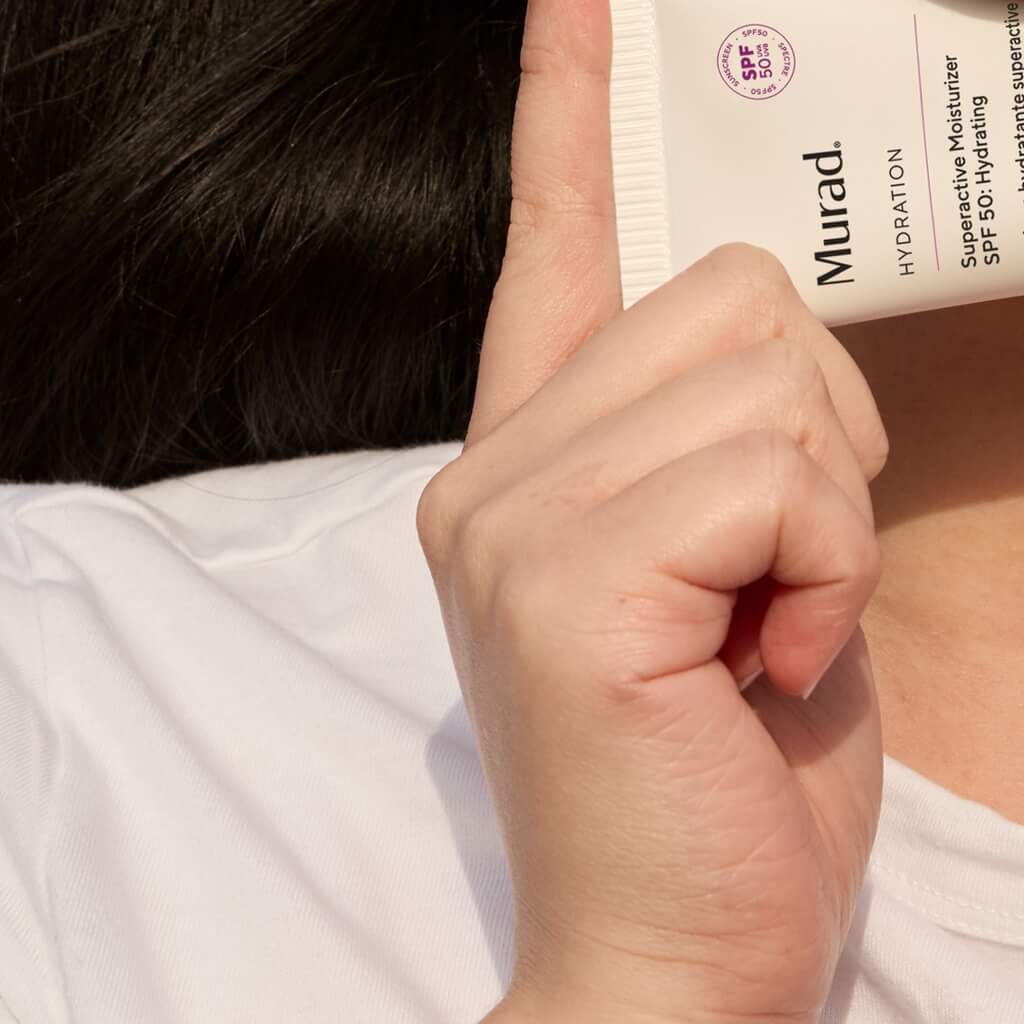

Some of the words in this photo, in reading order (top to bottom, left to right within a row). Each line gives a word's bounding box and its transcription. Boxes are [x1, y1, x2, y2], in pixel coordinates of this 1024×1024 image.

[722, 43, 740, 87] SUNSCREEN
[739, 45, 757, 80] SPF
[758, 58, 773, 78] 50
[778, 42, 791, 76] SPECTRE
[944, 55, 965, 152] Moisturizer
[970, 95, 994, 184] Hydrating
[887, 148, 915, 276] HYDRATION
[952, 156, 979, 269] Superactive
[977, 189, 995, 221] 50:
[980, 227, 1000, 265] SPF
